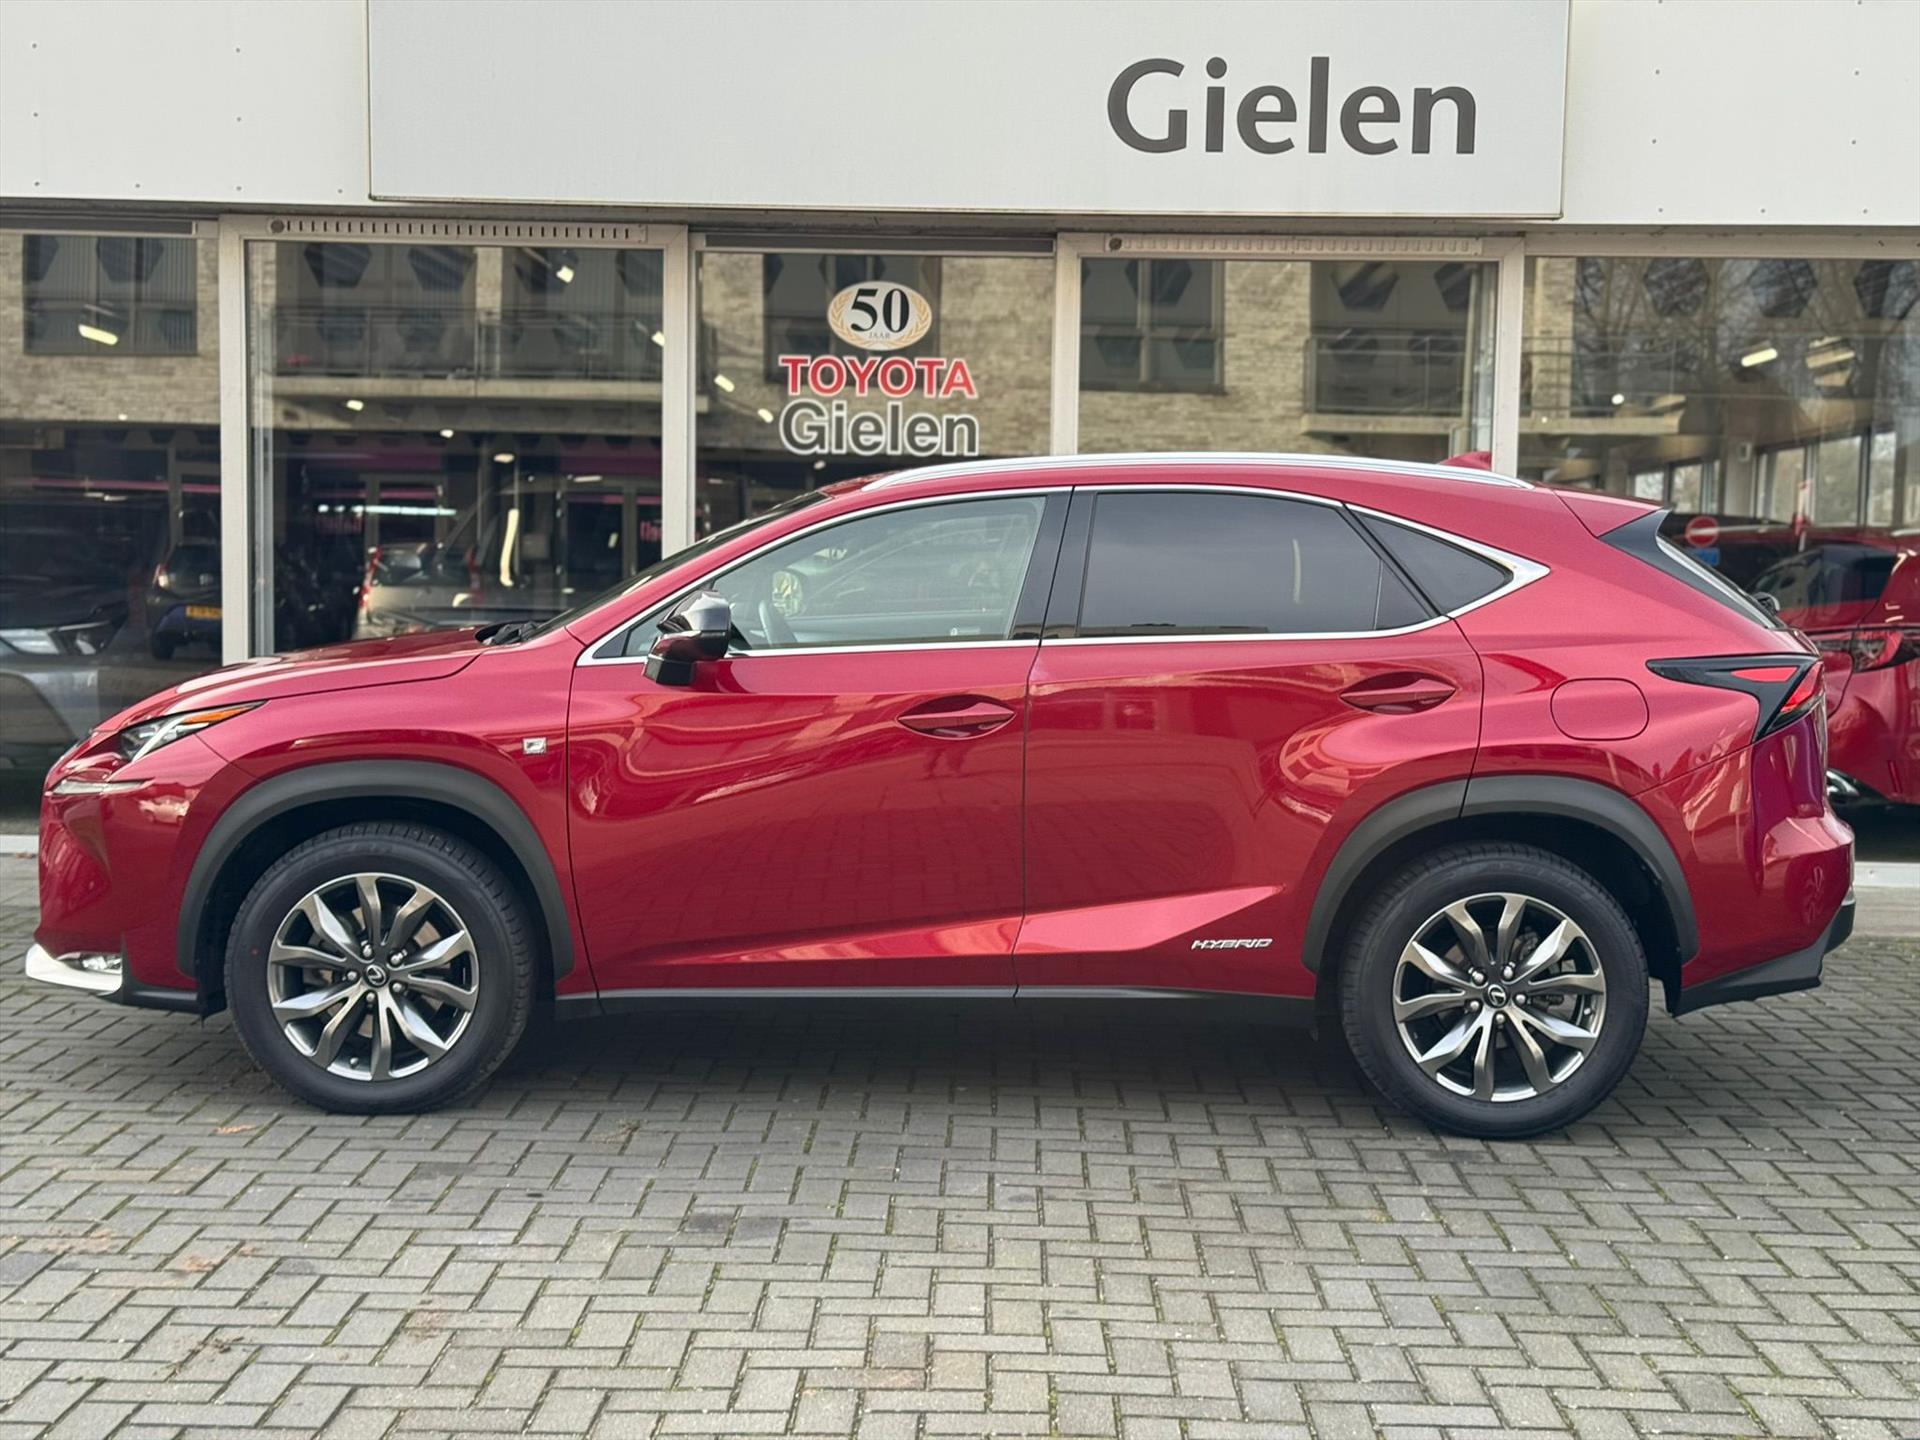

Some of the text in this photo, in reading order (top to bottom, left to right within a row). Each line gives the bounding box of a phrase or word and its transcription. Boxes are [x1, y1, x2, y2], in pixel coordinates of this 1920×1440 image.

[1107, 56, 1476, 155] Gielen
[850, 288, 910, 332] 50
[779, 355, 978, 398] TOYOTA
[779, 400, 979, 456] Gielen
[1191, 938, 1273, 950] HYBRID
